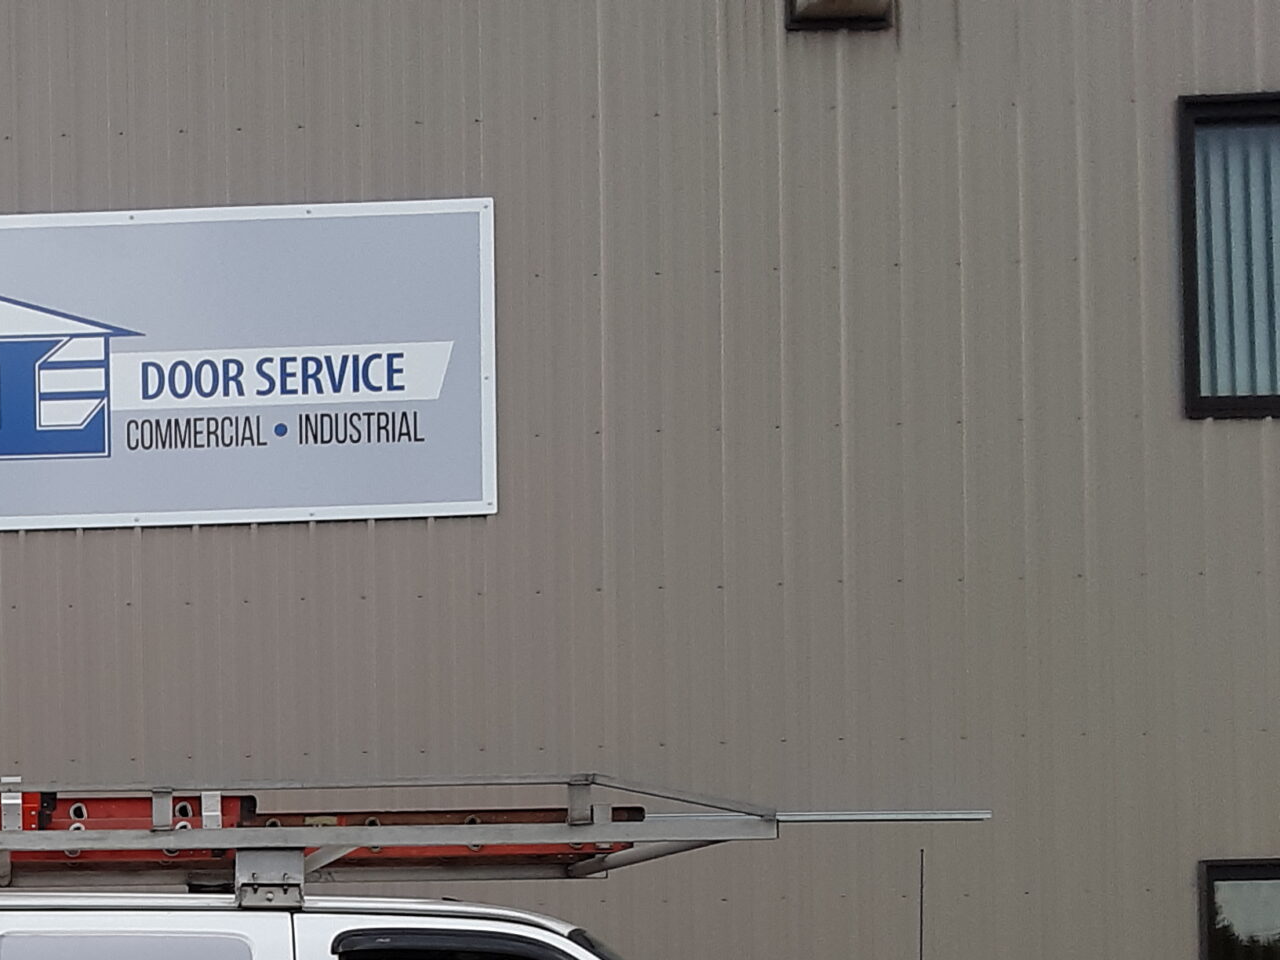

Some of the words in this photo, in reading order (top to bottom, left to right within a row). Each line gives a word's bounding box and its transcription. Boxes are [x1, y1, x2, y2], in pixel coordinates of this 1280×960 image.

[140, 357, 244, 401] DOOR
[255, 352, 406, 396] SERVICE
[126, 416, 268, 450] COMMERCIAL
[298, 411, 425, 445] INDUSTRIAL
